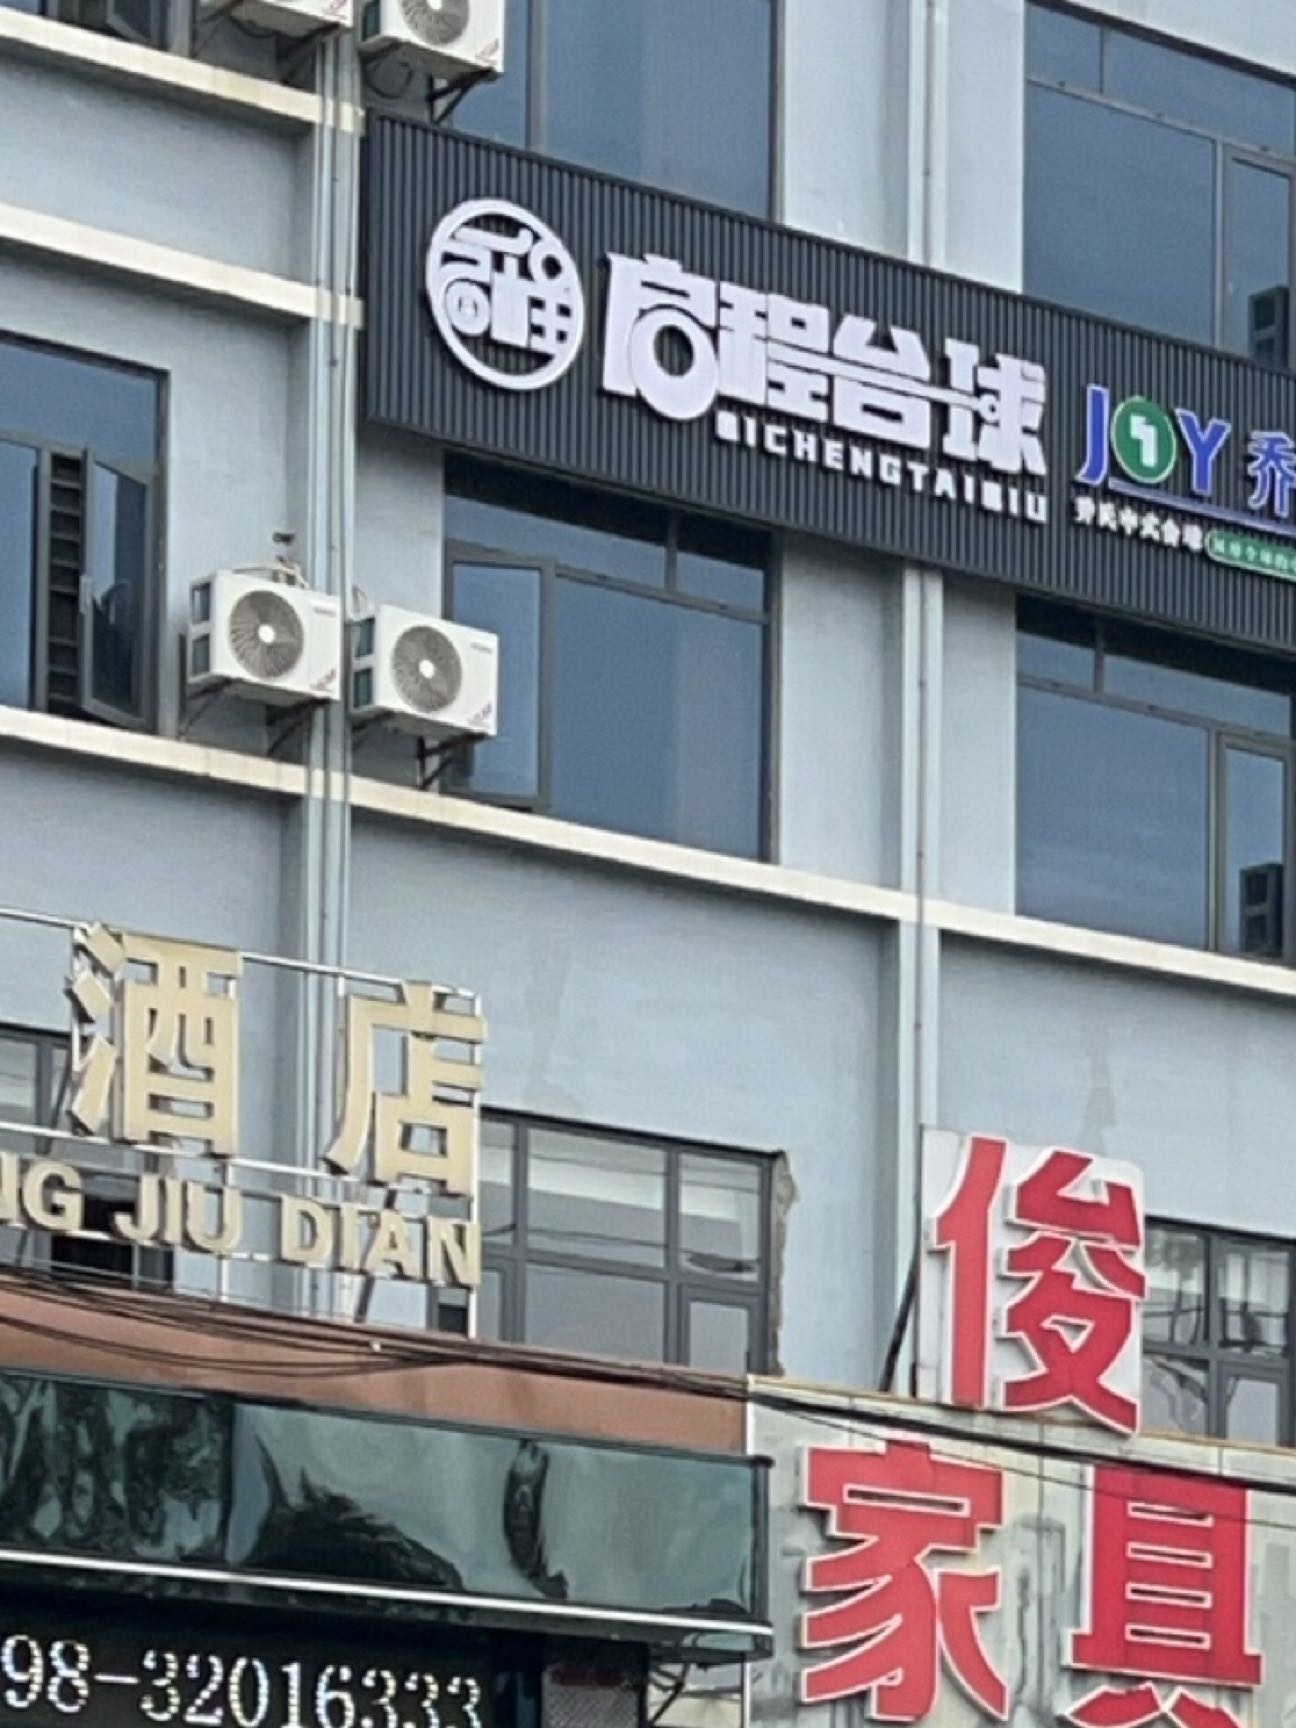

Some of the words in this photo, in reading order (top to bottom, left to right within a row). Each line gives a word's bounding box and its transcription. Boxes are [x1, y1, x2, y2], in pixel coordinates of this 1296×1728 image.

[66, 921, 486, 1195] 酒店
[114, 1174, 243, 1258] JIU
[279, 1194, 481, 1287] DIAN
